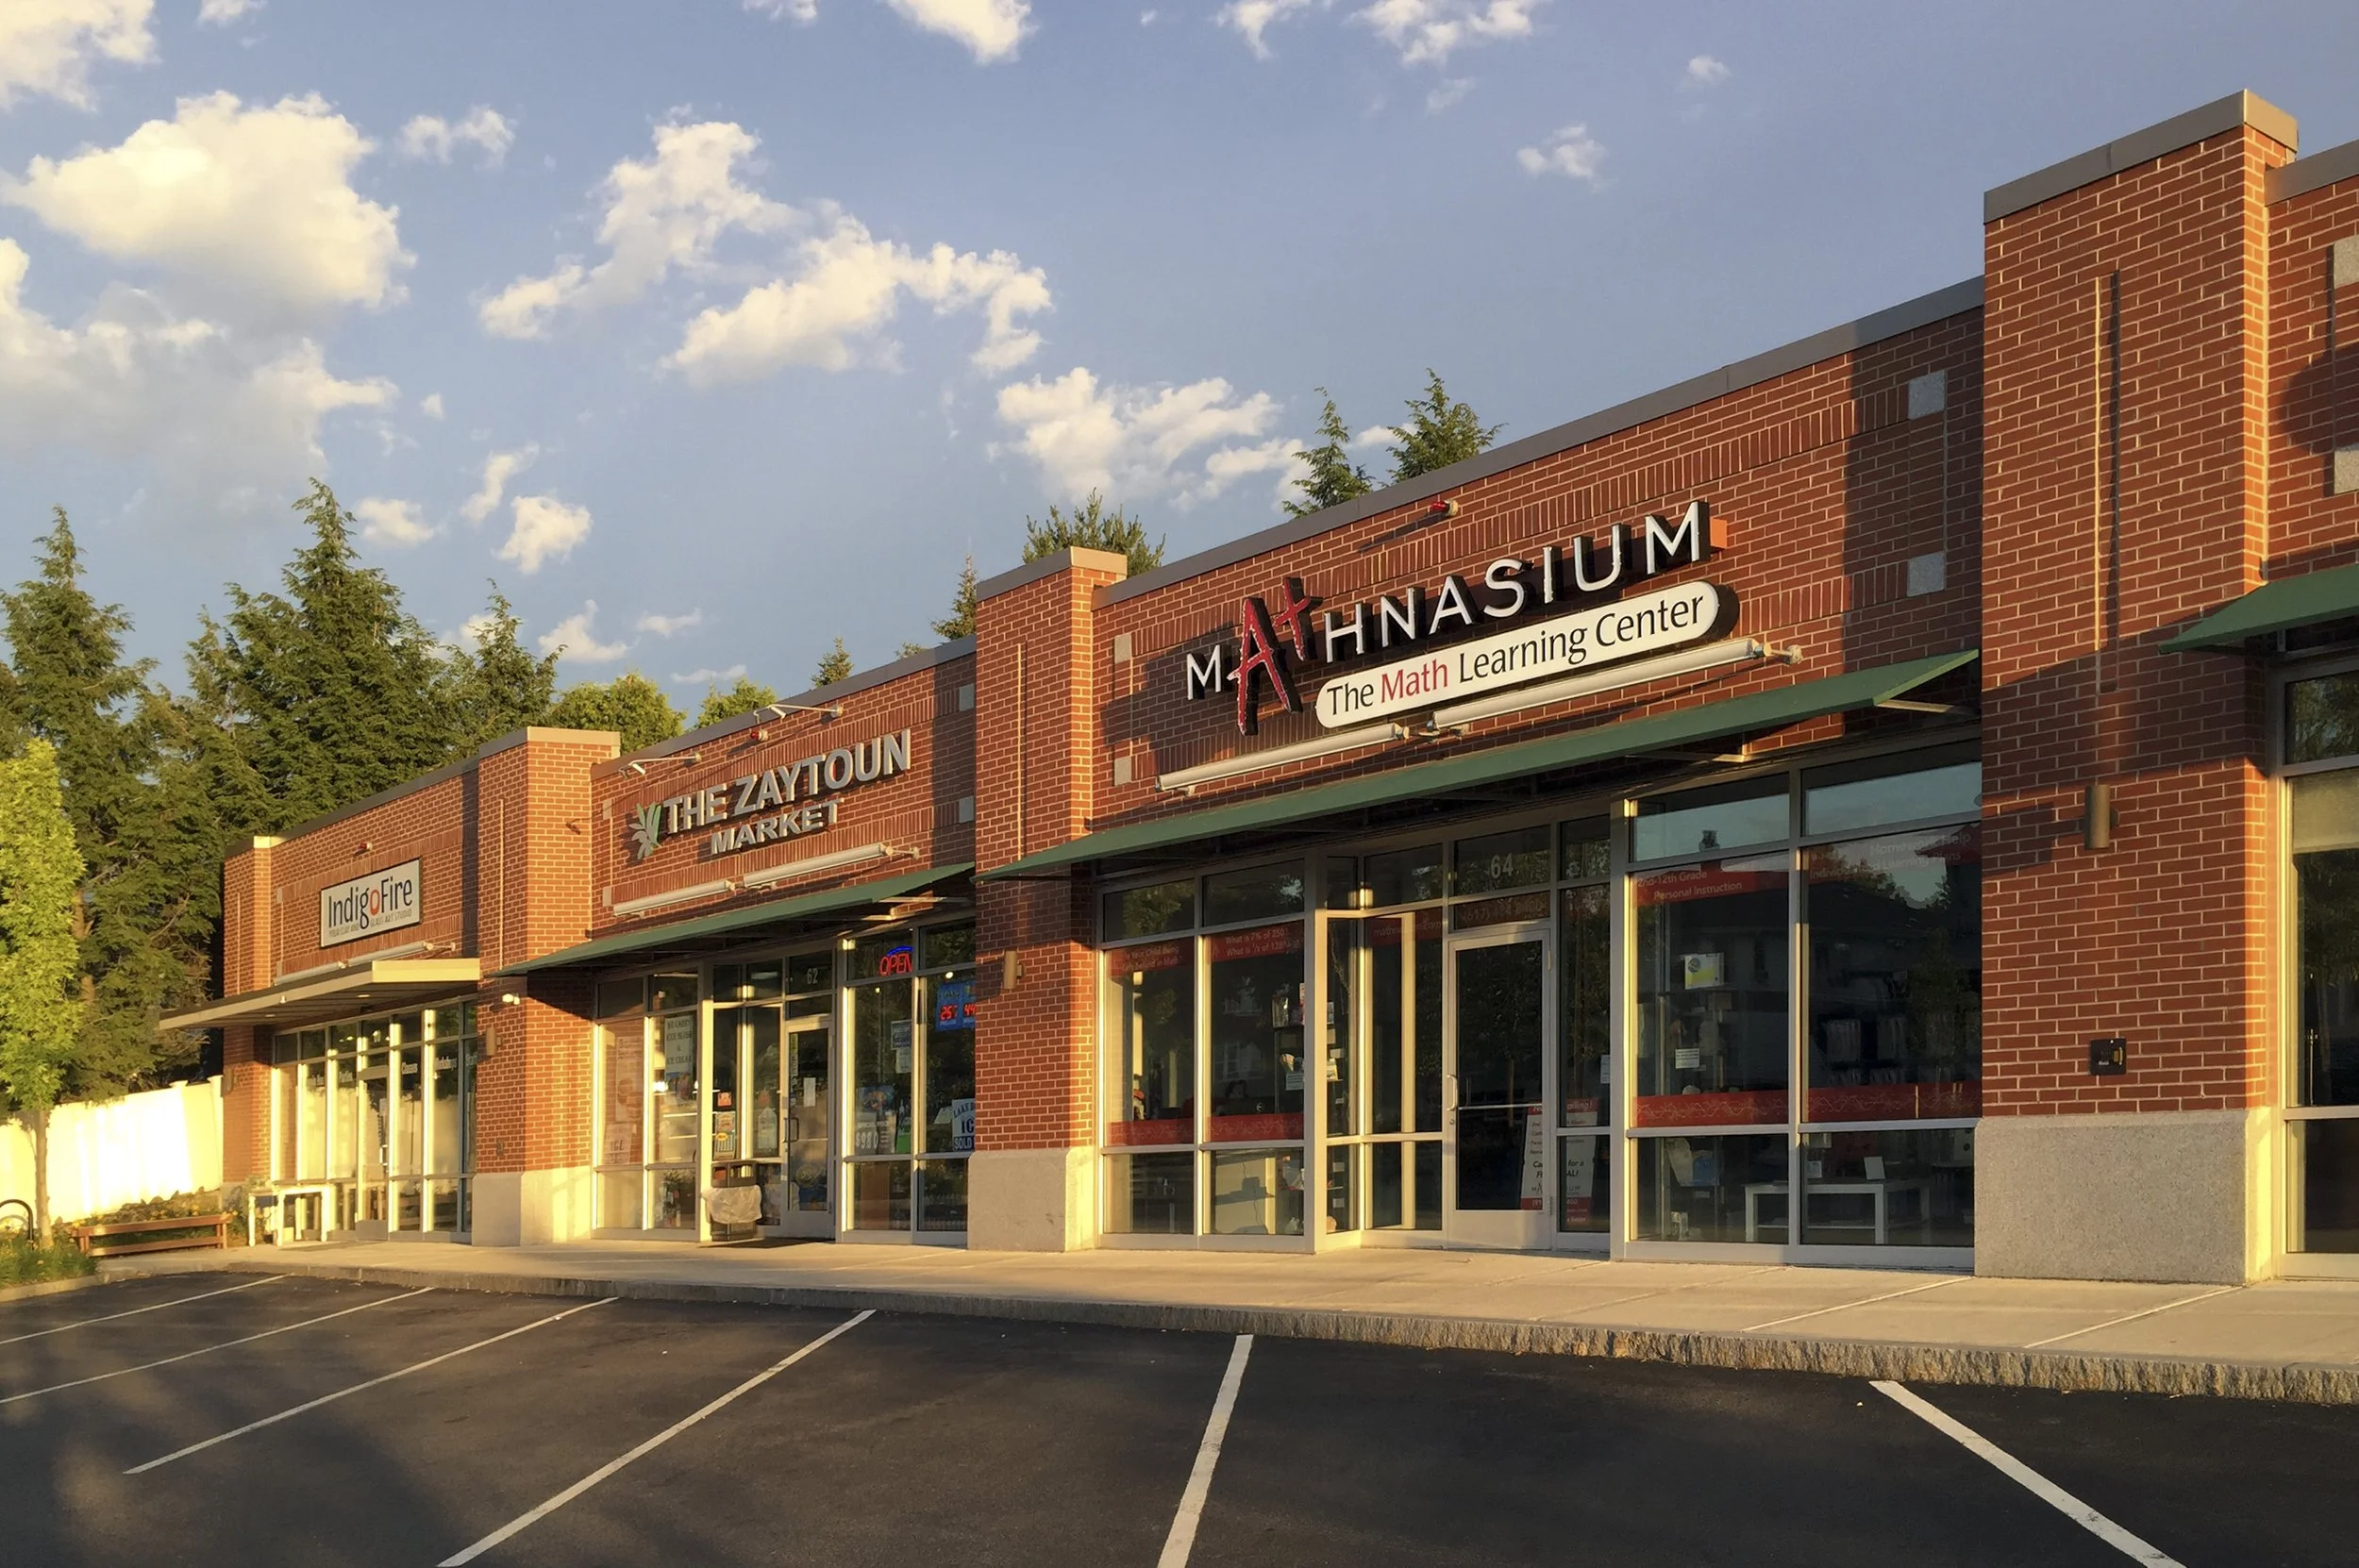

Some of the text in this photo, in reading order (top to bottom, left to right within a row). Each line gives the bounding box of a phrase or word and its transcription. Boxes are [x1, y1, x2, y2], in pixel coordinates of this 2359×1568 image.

[1326, 592, 1704, 716] The Math Learning Center
[663, 729, 912, 834] THE ZAYTOUN
[711, 797, 845, 855] MARKET
[1490, 853, 1514, 879] 64
[1679, 870, 1708, 883] Grade
[1653, 881, 1743, 900] Personal Instruction
[328, 876, 412, 929] IndigoFire
[807, 967, 819, 985] 62
[879, 953, 913, 976] OPEN
[962, 1118, 975, 1134] IC
[954, 1137, 972, 1150] SOLD
